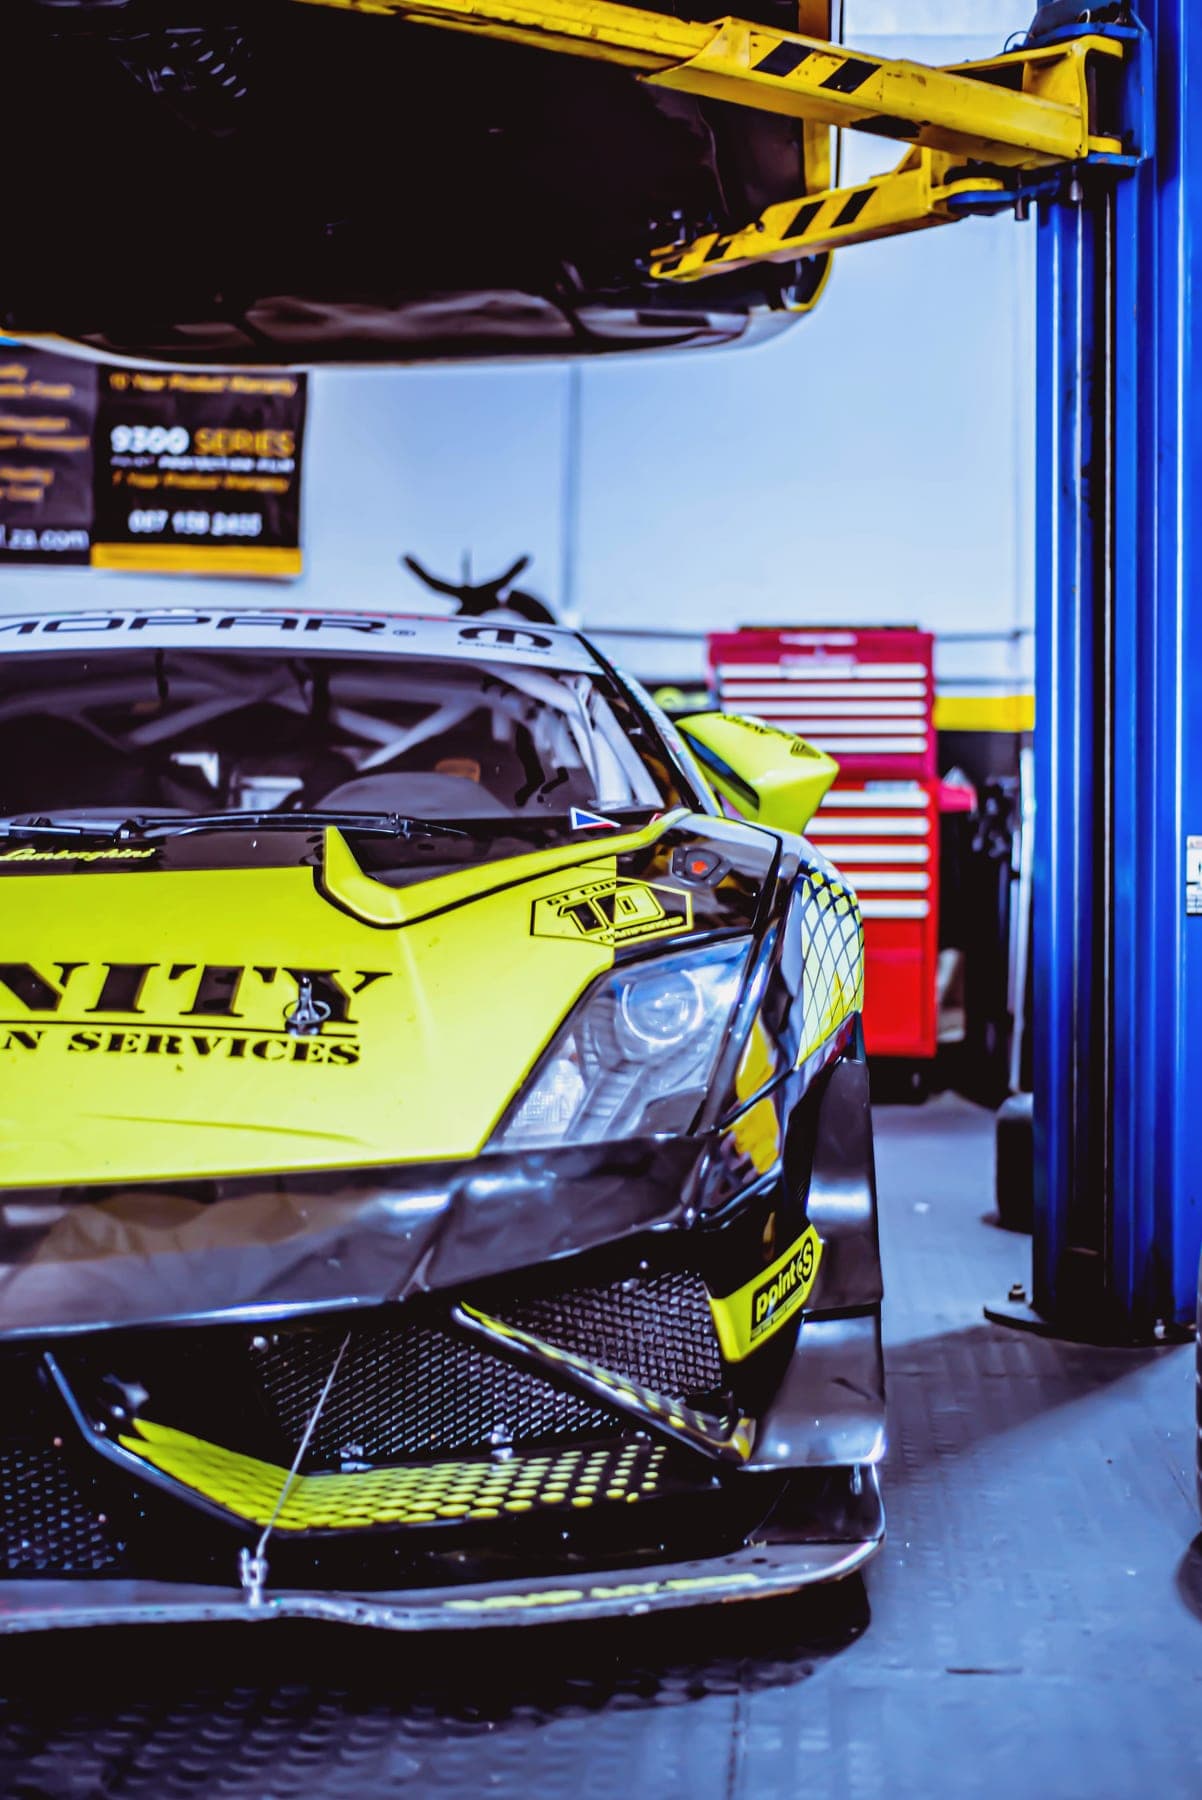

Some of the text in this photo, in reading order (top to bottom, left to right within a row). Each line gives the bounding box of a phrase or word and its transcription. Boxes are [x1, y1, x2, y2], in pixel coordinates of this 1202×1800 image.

[110, 425, 190, 455] 9300
[194, 428, 295, 457] SERIES
[67, 1031, 361, 1065] SERVICES
